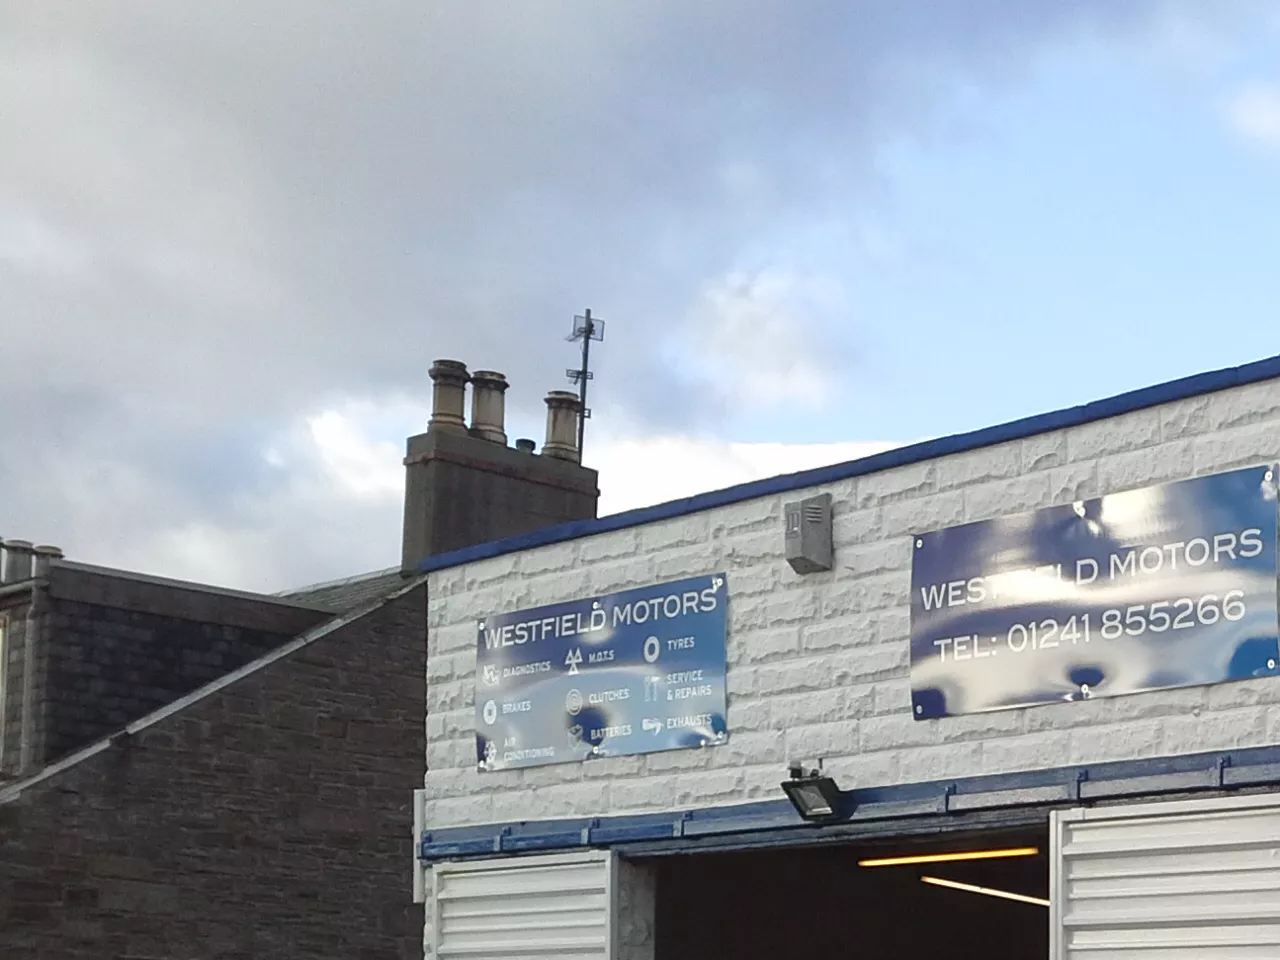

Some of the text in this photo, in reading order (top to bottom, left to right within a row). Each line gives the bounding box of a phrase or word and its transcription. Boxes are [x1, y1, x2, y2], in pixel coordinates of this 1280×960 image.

[921, 529, 1263, 610] WESLD MOTORS
[483, 588, 717, 650] WESTFIELD MOTORS
[934, 590, 1246, 663] TEL: 01241 855266
[667, 636, 695, 651] TYRES
[503, 661, 551, 677] DIAGNOSTICS
[667, 670, 703, 685] SERVICE
[589, 688, 630, 704] CLUTCHES
[675, 684, 712, 700] REPAIRS
[503, 701, 532, 714] BRAKES
[666, 714, 713, 729] EXHAUSTS
[591, 725, 632, 740] BATTERIES
